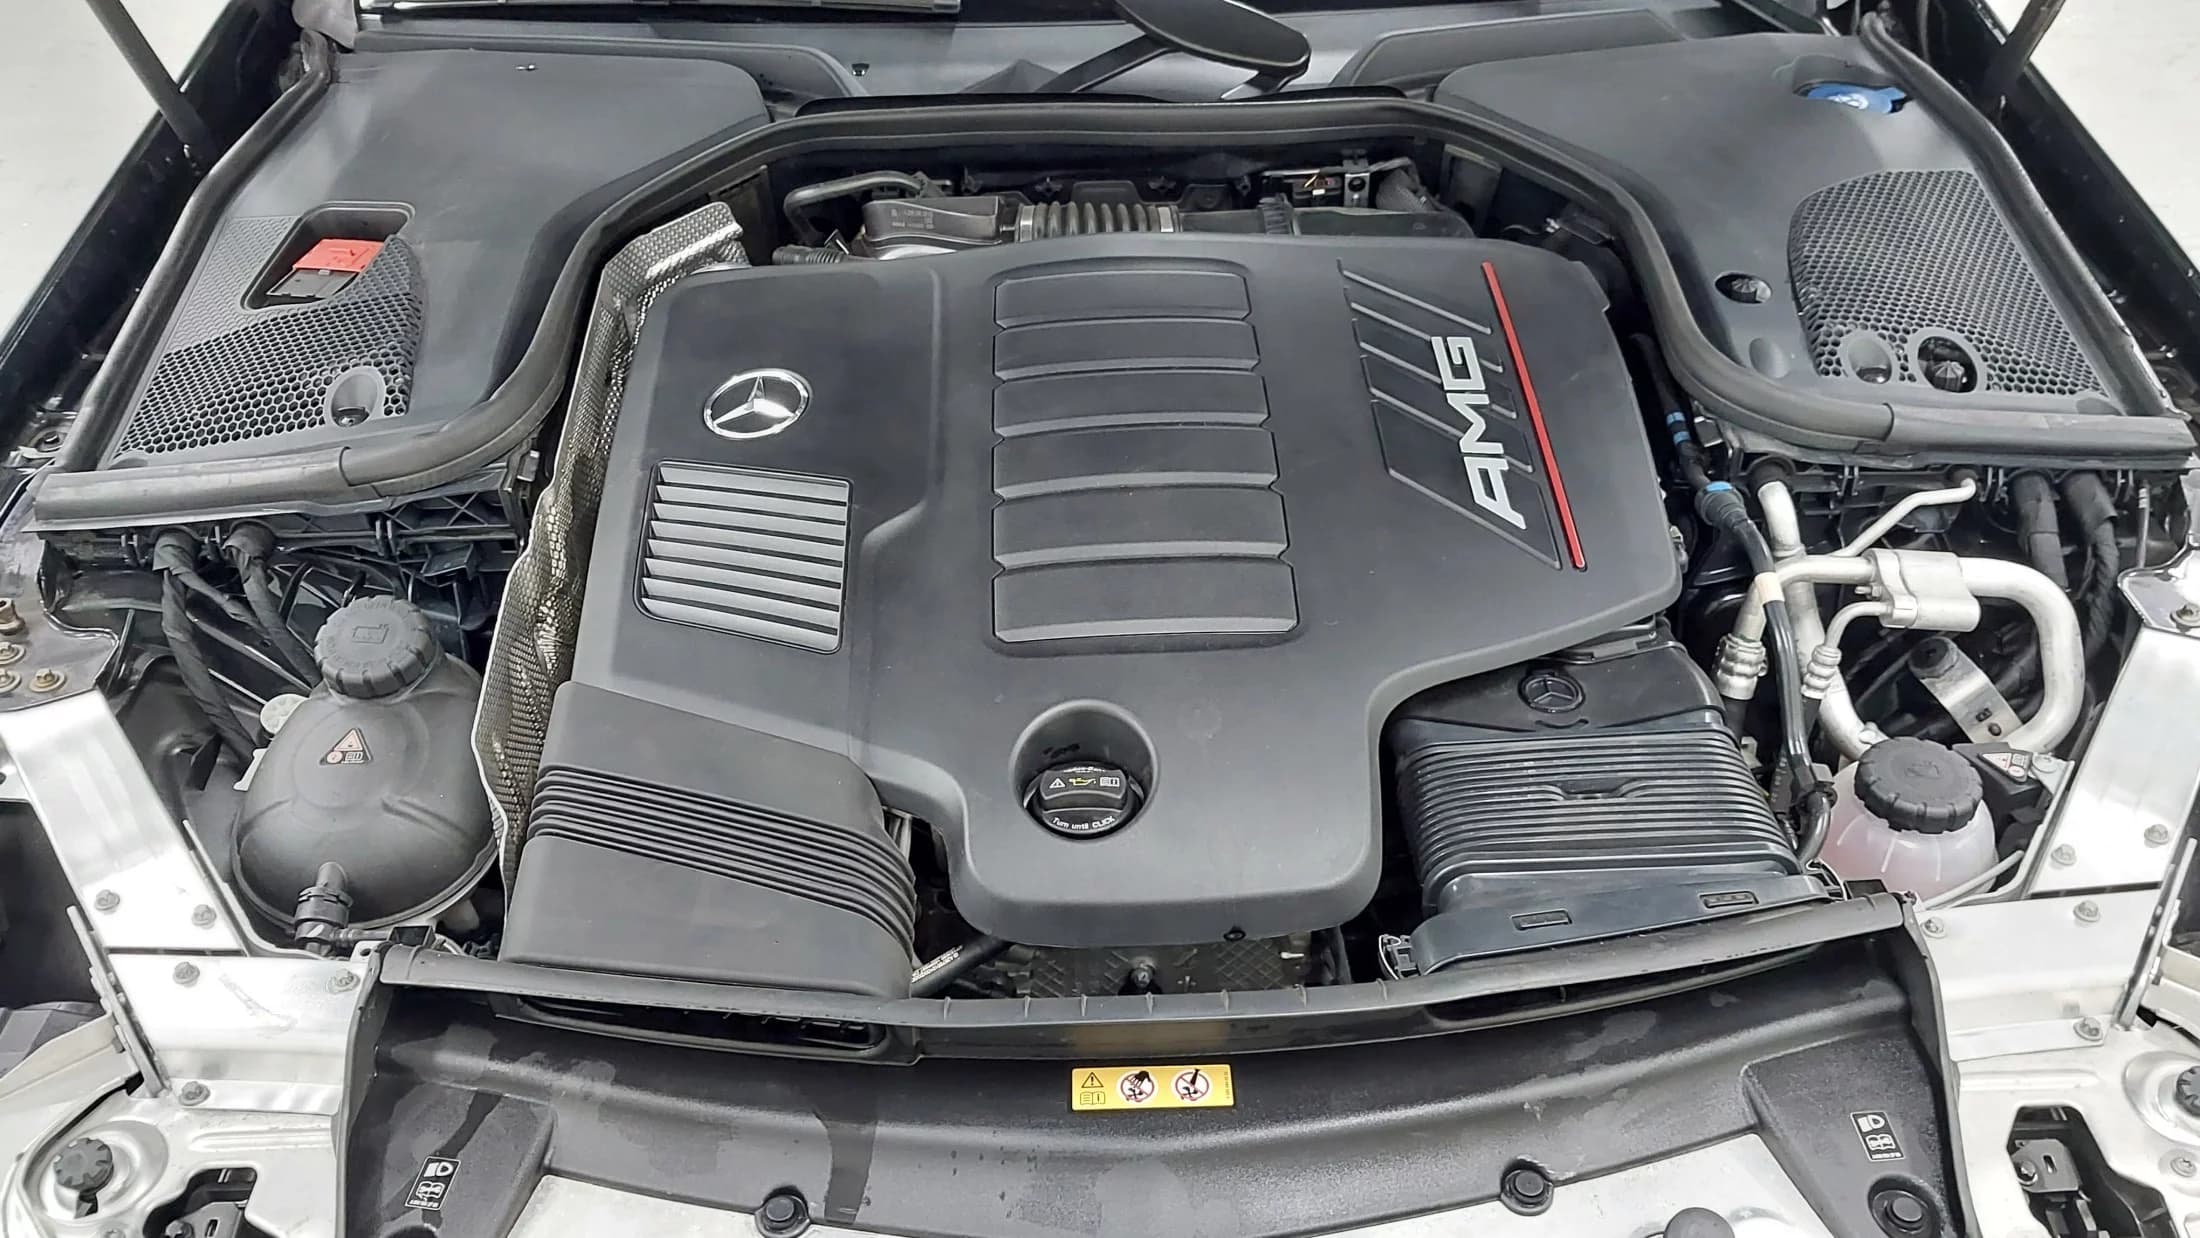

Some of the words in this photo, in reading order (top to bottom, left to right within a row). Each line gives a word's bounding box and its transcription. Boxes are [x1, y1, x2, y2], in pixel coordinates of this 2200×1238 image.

[1431, 336, 1527, 530] AMG
[1053, 817, 1069, 829] Turn
[1092, 815, 1115, 829] CLICK
